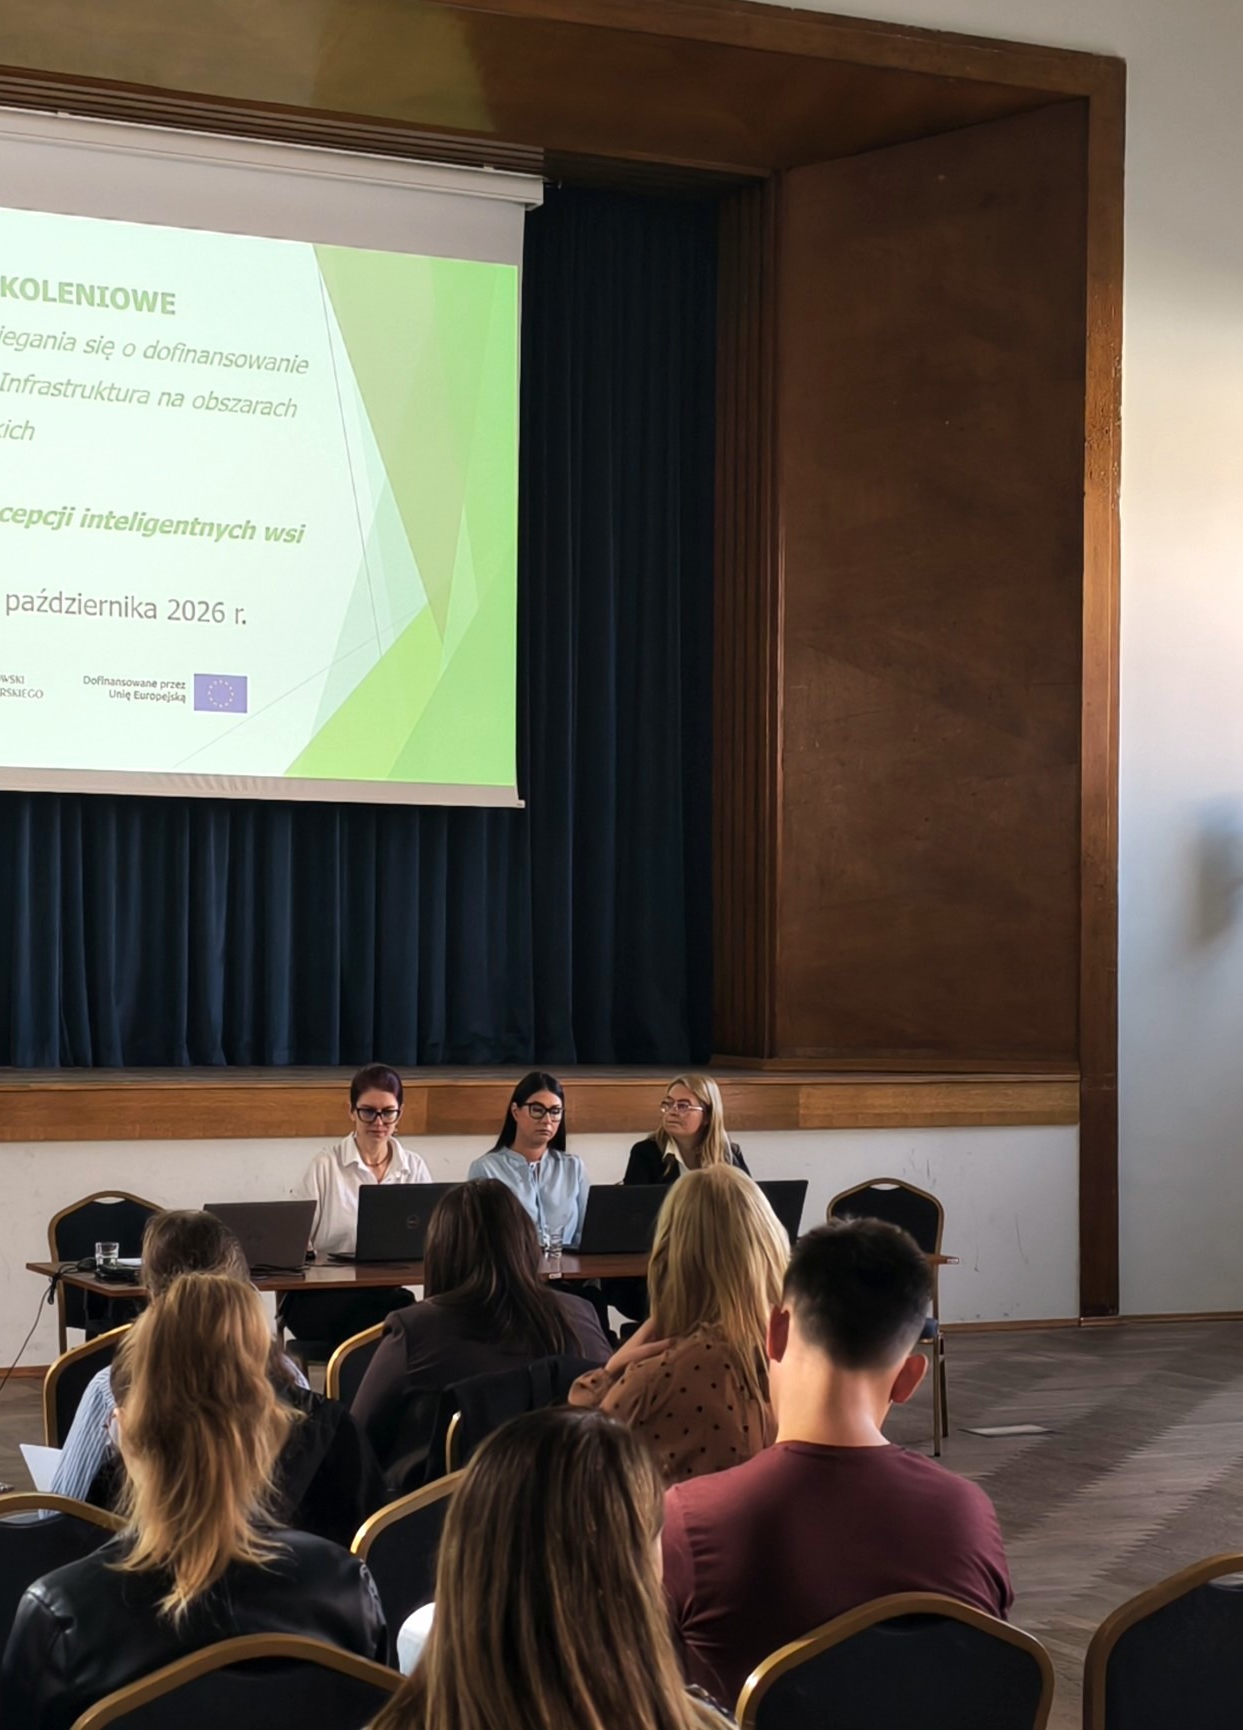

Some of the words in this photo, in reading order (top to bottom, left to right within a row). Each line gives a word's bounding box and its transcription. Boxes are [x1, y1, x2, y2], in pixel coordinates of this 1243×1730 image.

[83, 335, 115, 361] się
[122, 343, 136, 357] o
[143, 340, 310, 375] dofinansowanie
[158, 391, 185, 408] na
[192, 391, 298, 418] obszarach
[80, 508, 256, 542] inteligentnych
[264, 524, 306, 544] wsi
[6, 588, 157, 619] października
[167, 599, 225, 623] 2026
[235, 607, 247, 625] r.
[83, 675, 157, 688] Dofinansowane
[160, 680, 186, 691] przez
[109, 689, 131, 701] Unię
[133, 690, 186, 704] Europejską
